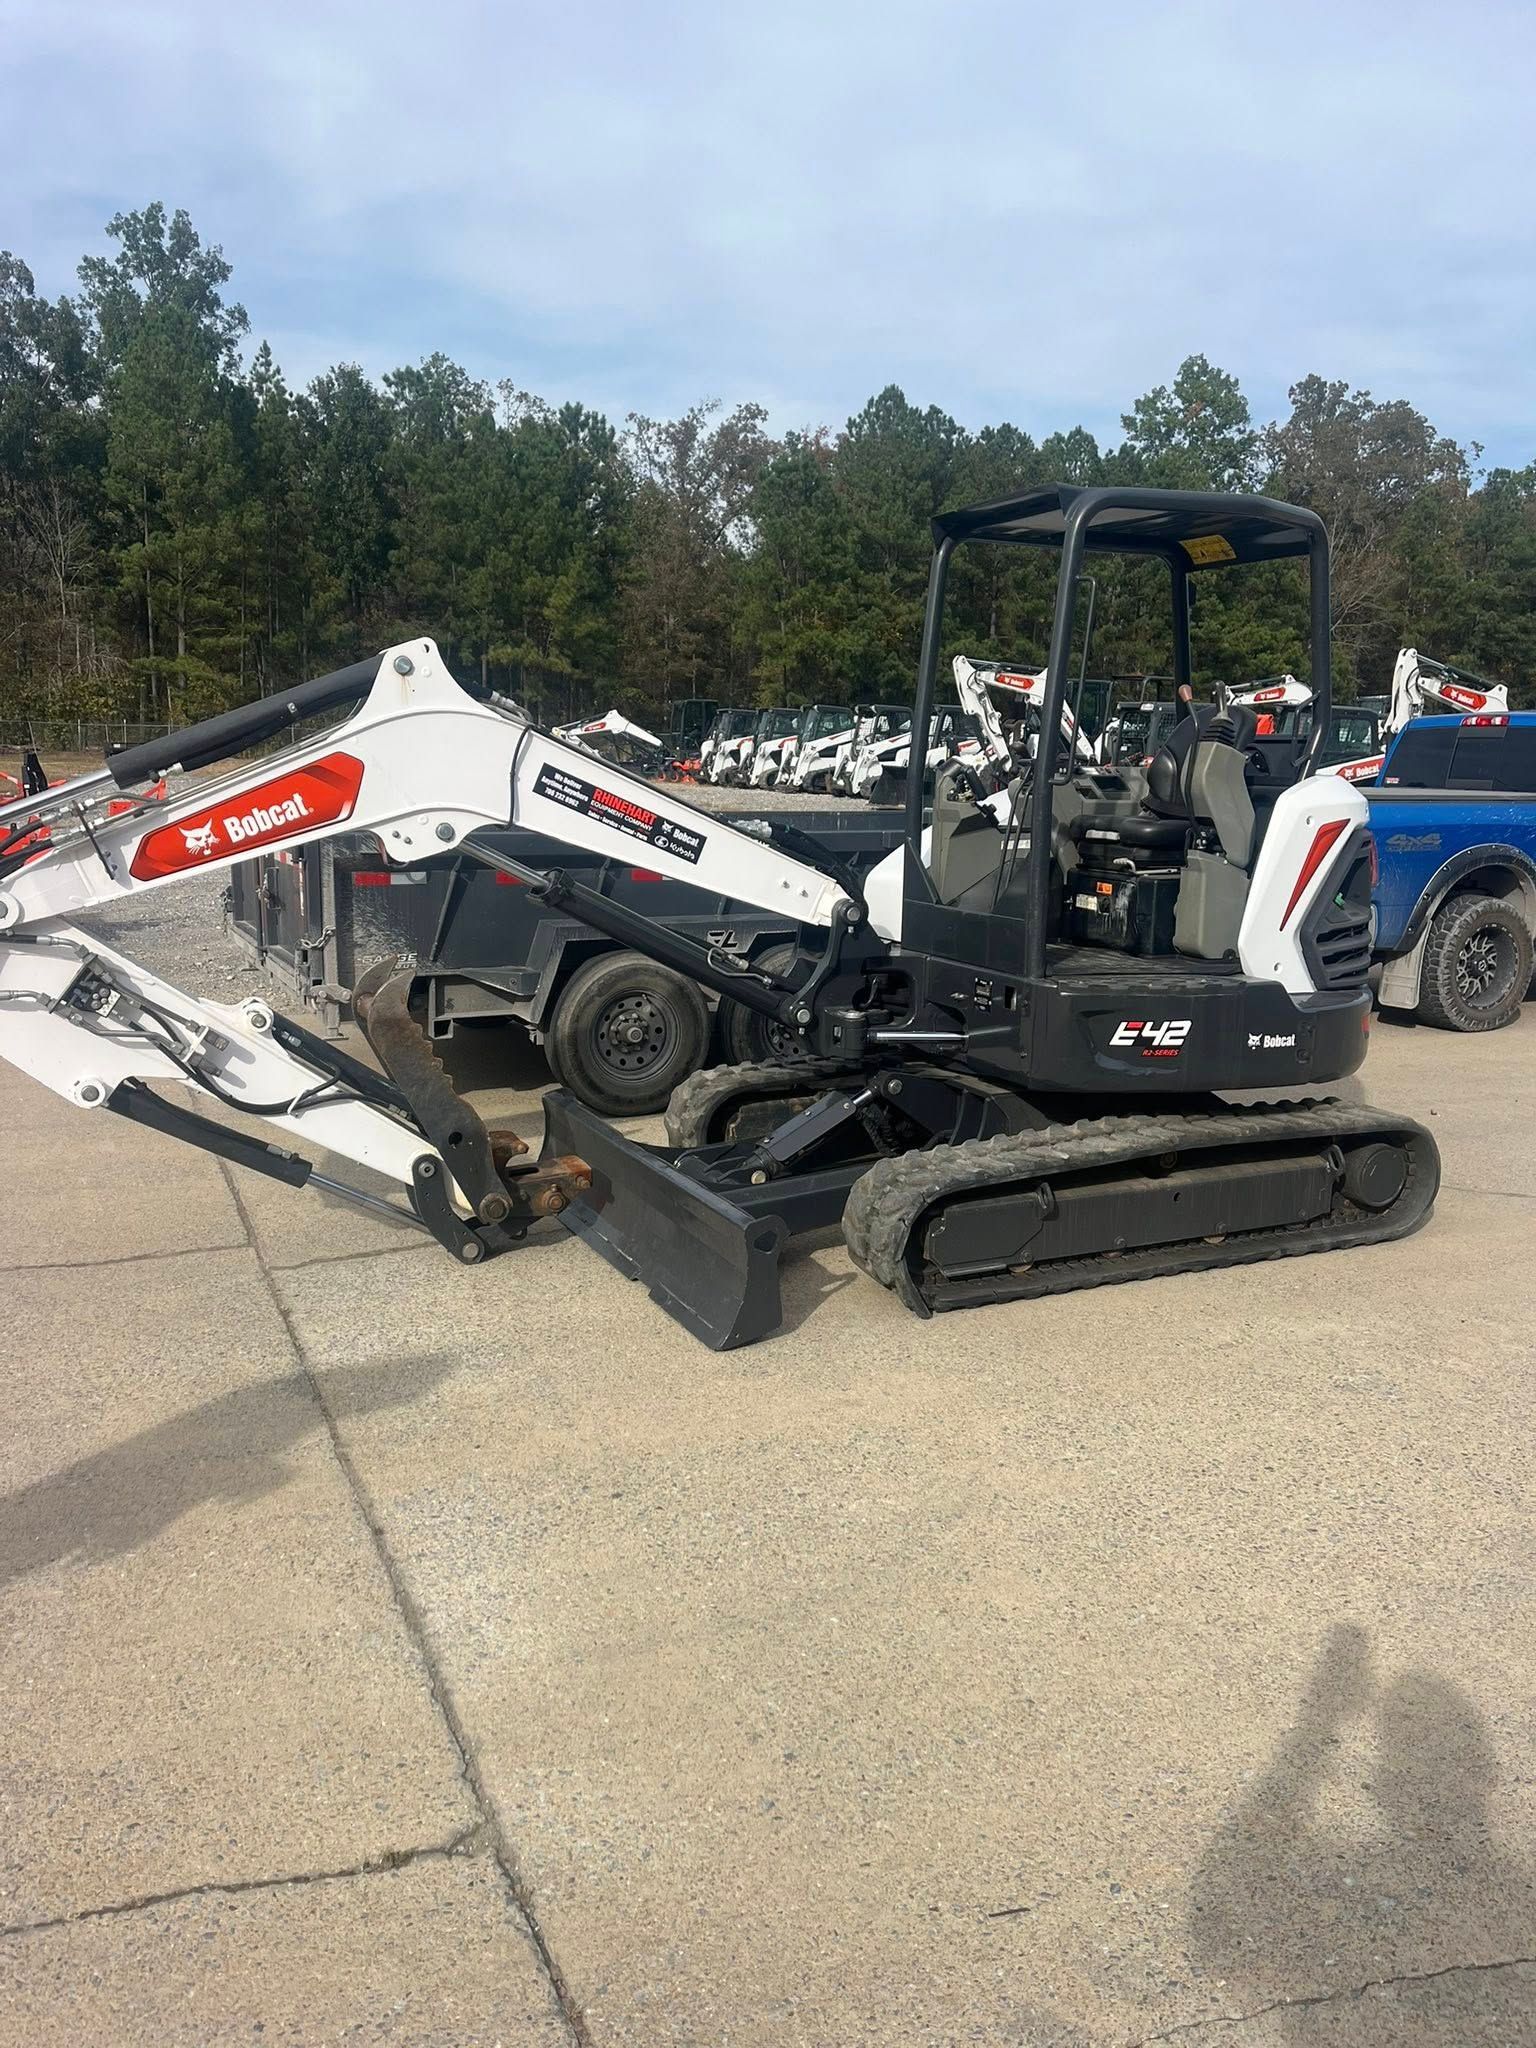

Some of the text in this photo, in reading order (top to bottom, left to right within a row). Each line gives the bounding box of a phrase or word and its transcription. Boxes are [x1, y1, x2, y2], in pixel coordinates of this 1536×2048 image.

[223, 793, 309, 843] Bobcat
[590, 799, 624, 819] EQUIPMENT
[624, 815, 653, 831] COMPANY
[593, 788, 657, 826] RHINEHART
[673, 828, 699, 847] Bobcat
[670, 842, 695, 860] Kubota
[1109, 1021, 1192, 1046] E42
[1263, 1034, 1296, 1048] Bobcat
[1142, 1049, 1180, 1057] R2-SERIES
